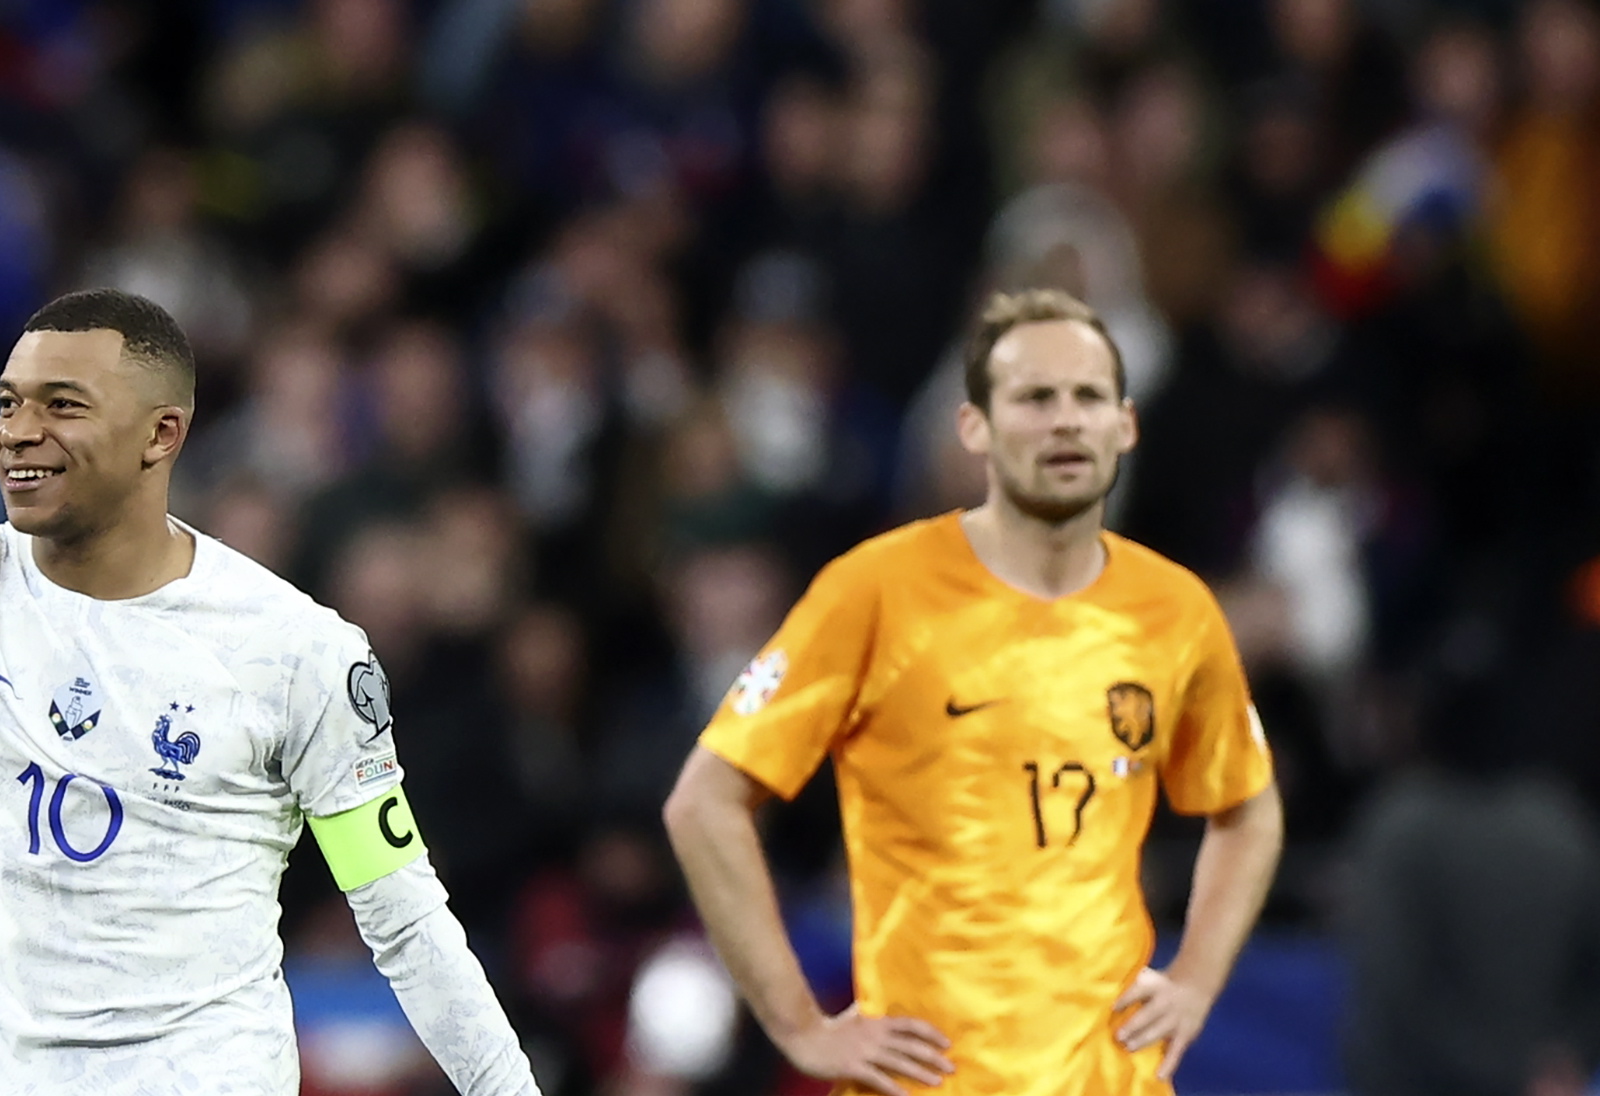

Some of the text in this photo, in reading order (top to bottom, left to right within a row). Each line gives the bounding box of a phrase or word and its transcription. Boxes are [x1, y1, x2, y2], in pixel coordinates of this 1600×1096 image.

[356, 760, 396, 781] FOUN
[1022, 761, 1096, 849] 17
[16, 760, 124, 863] 10
[378, 796, 414, 849] C
